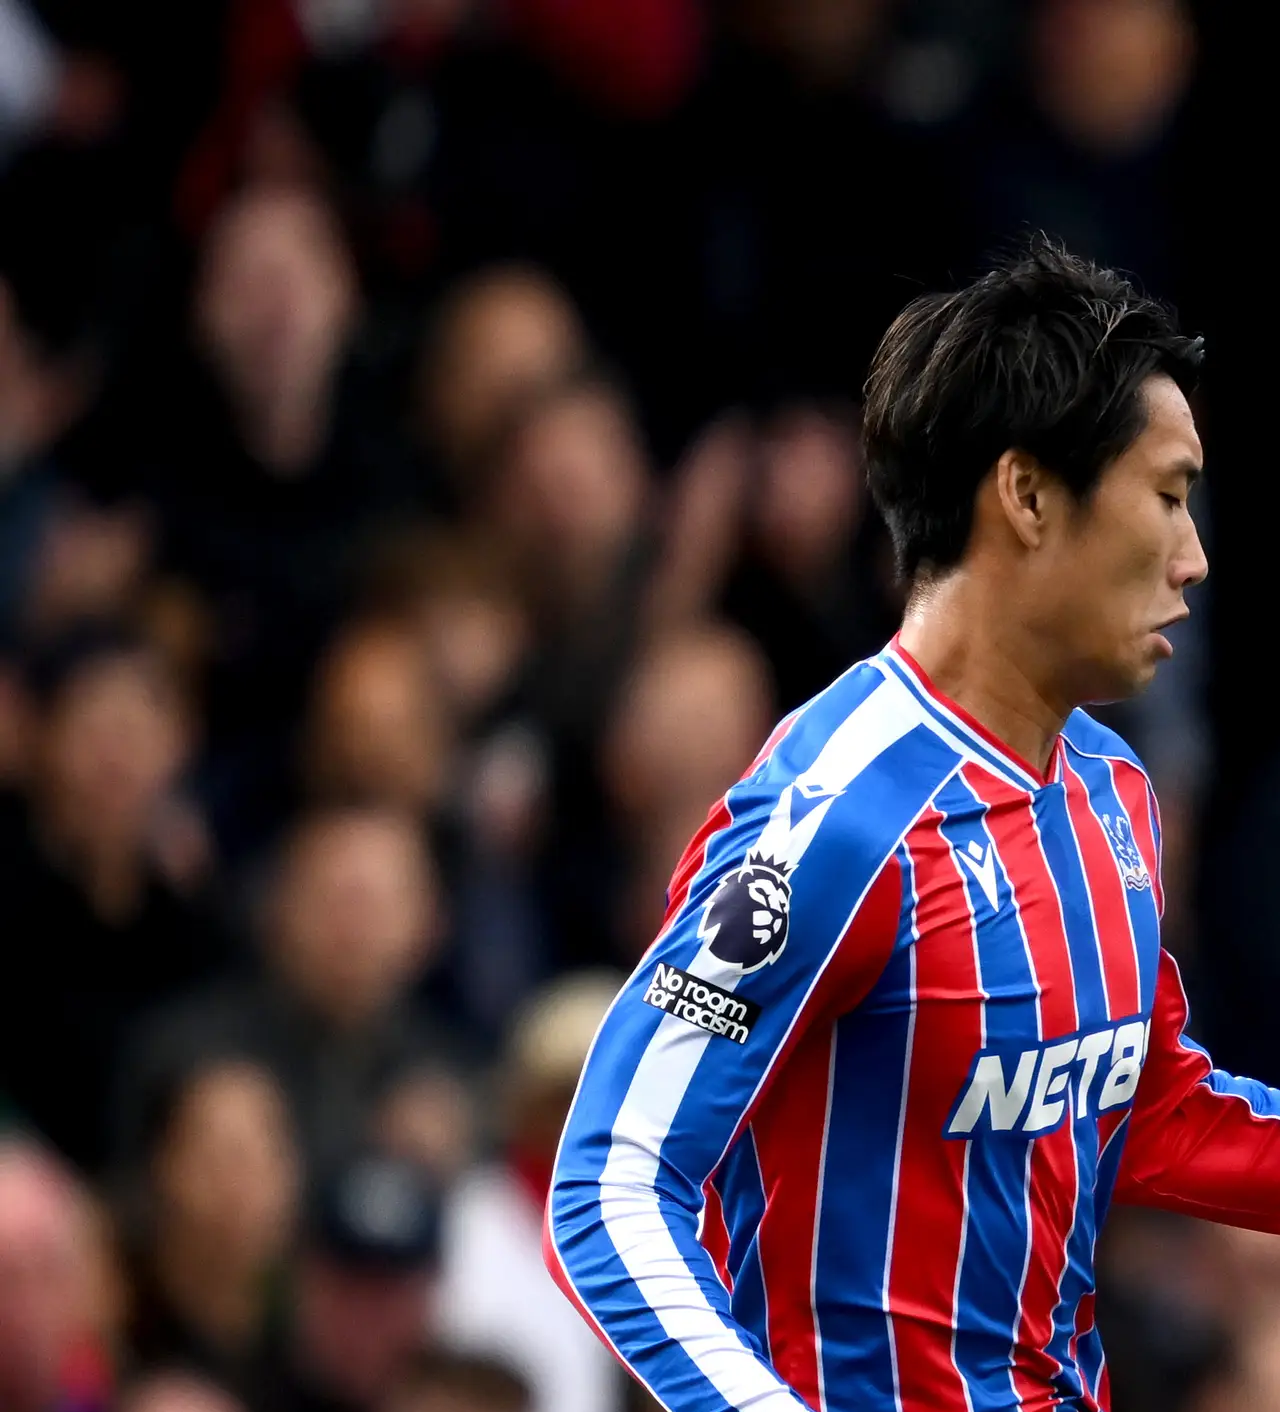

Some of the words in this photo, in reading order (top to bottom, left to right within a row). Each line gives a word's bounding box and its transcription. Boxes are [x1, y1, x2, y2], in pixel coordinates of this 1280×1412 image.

[642, 982, 675, 1010] for
[672, 998, 749, 1044] racism
[652, 962, 684, 992] No
[682, 980, 748, 1021] room
[948, 1017, 1152, 1133] NET8
